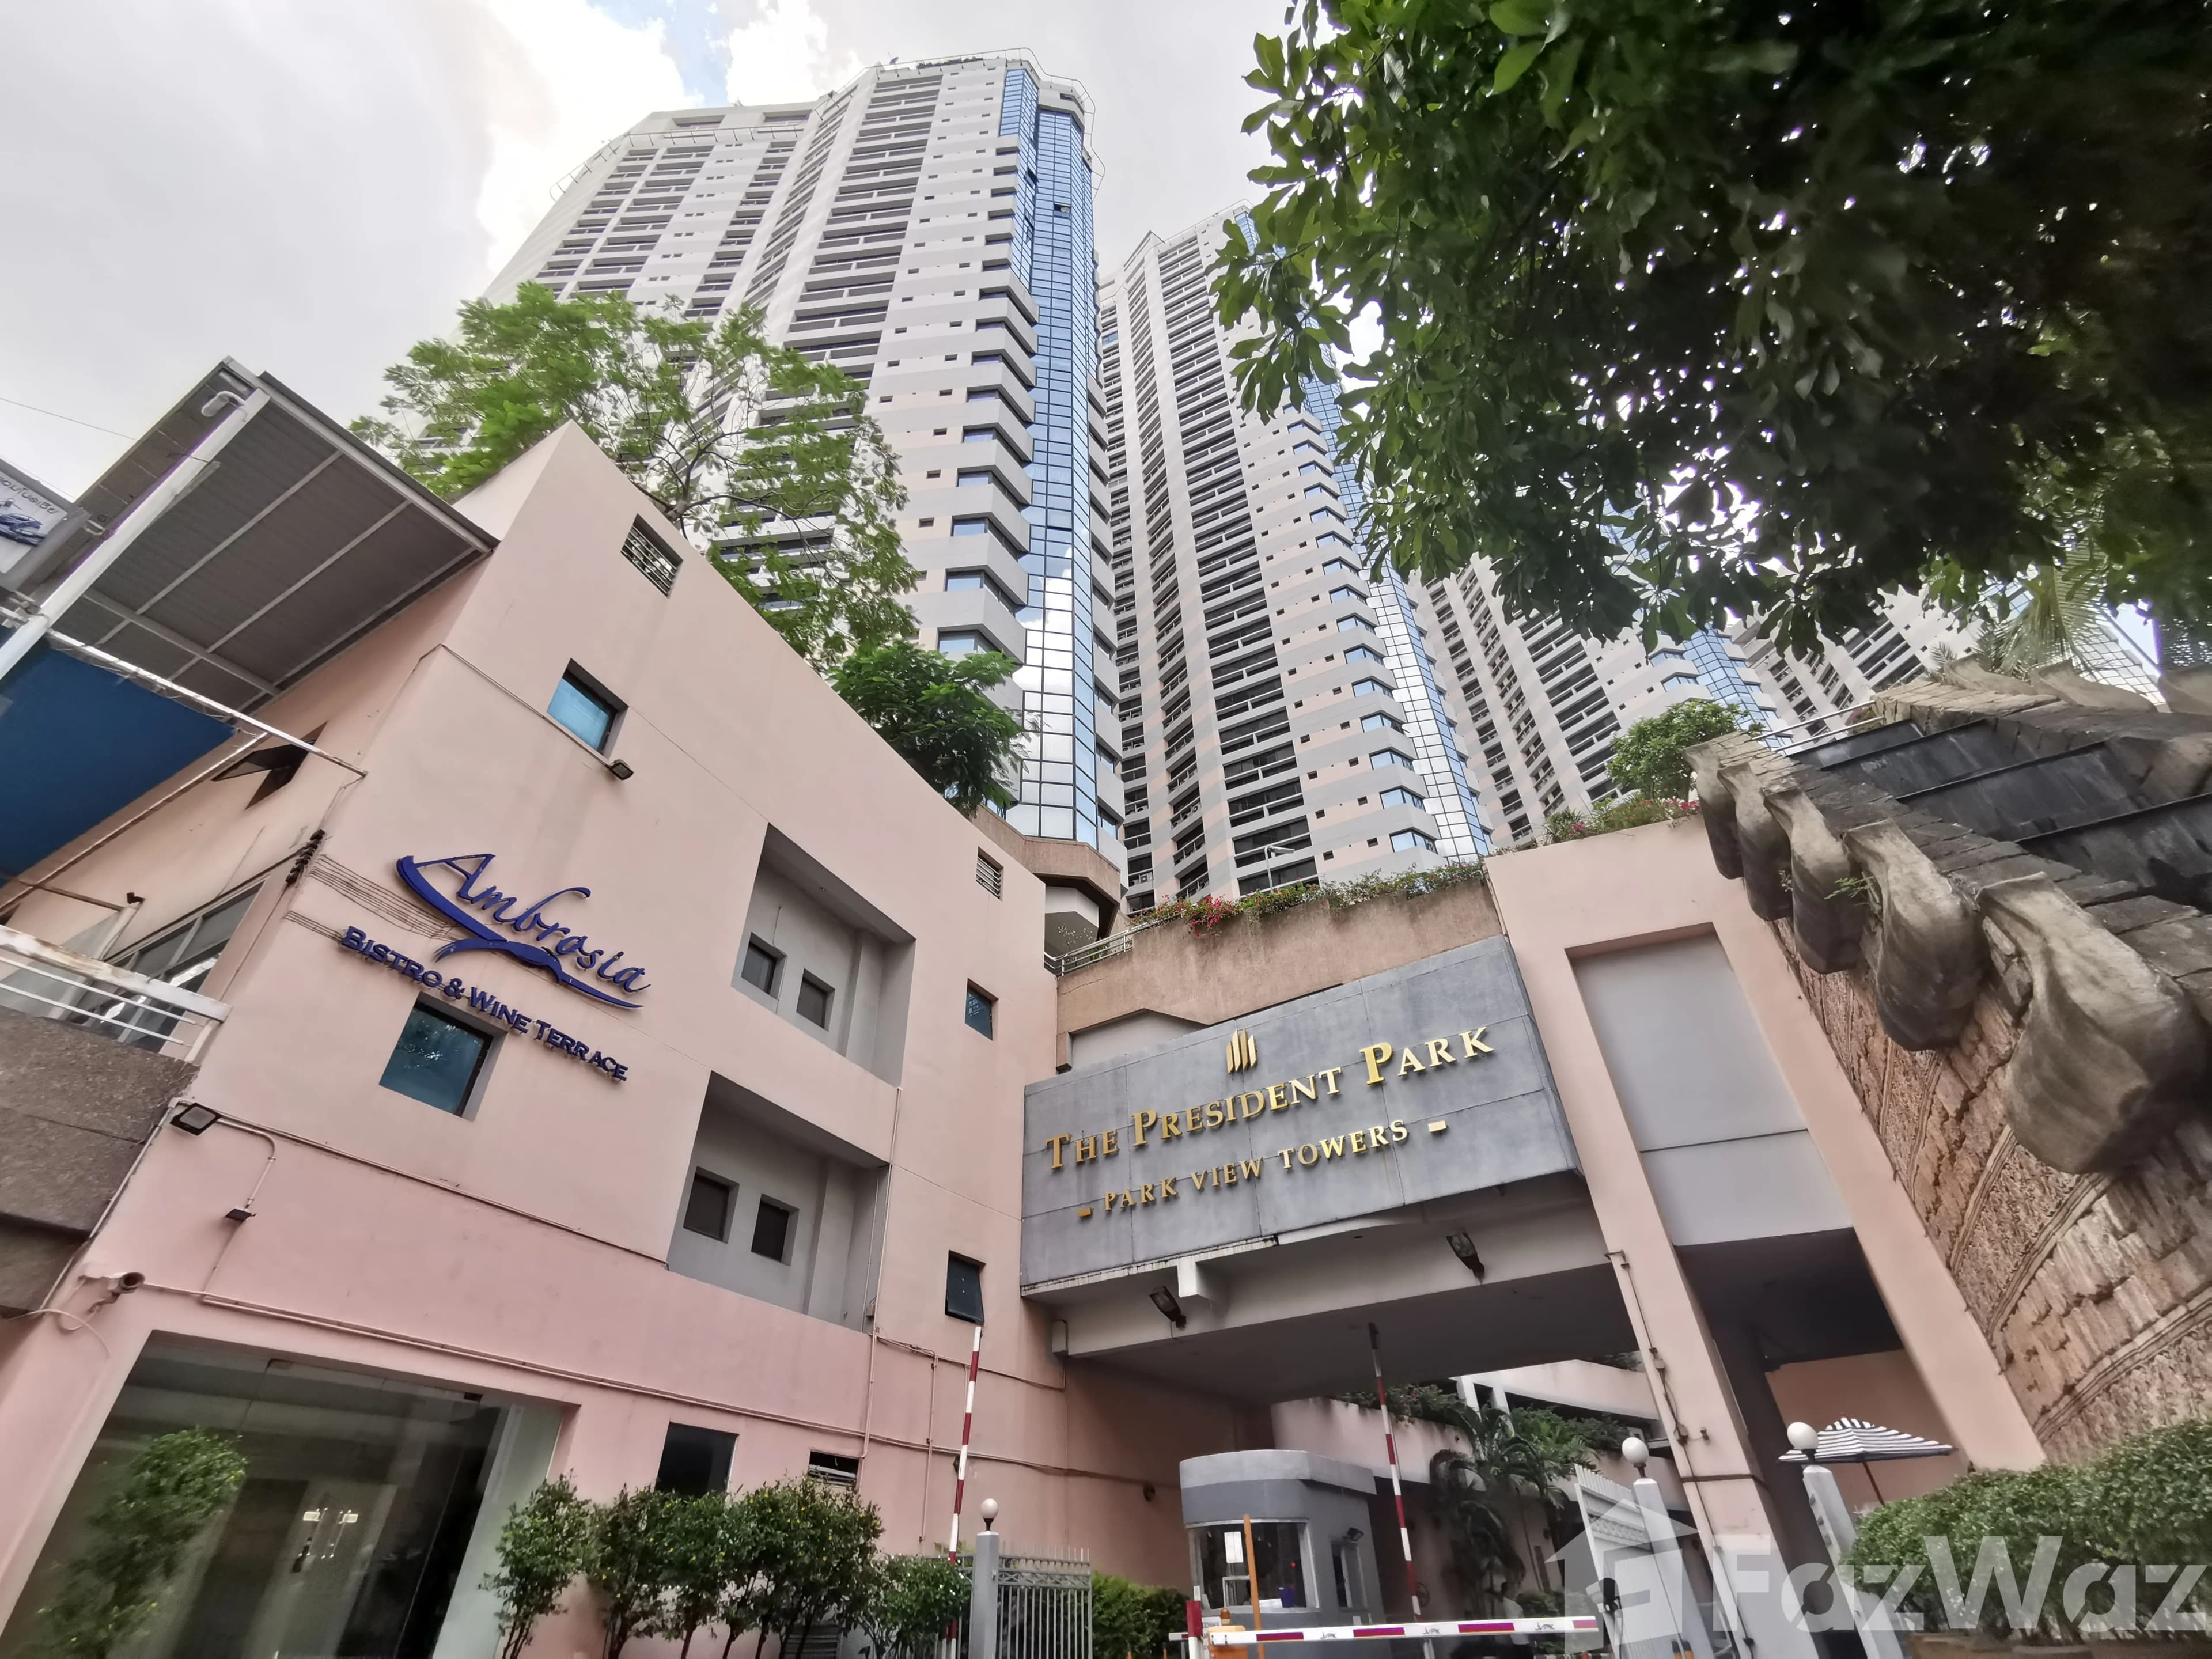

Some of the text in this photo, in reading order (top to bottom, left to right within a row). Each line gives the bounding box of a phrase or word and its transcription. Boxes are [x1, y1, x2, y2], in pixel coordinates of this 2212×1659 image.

[396, 853, 651, 993] Ambrosia
[341, 926, 628, 1081] BISTRO & WINE TERRACE
[1045, 1027, 1494, 1169] THE PRESIDENT PARK
[1103, 1119, 1409, 1212] PARK VIEW TOWERS
